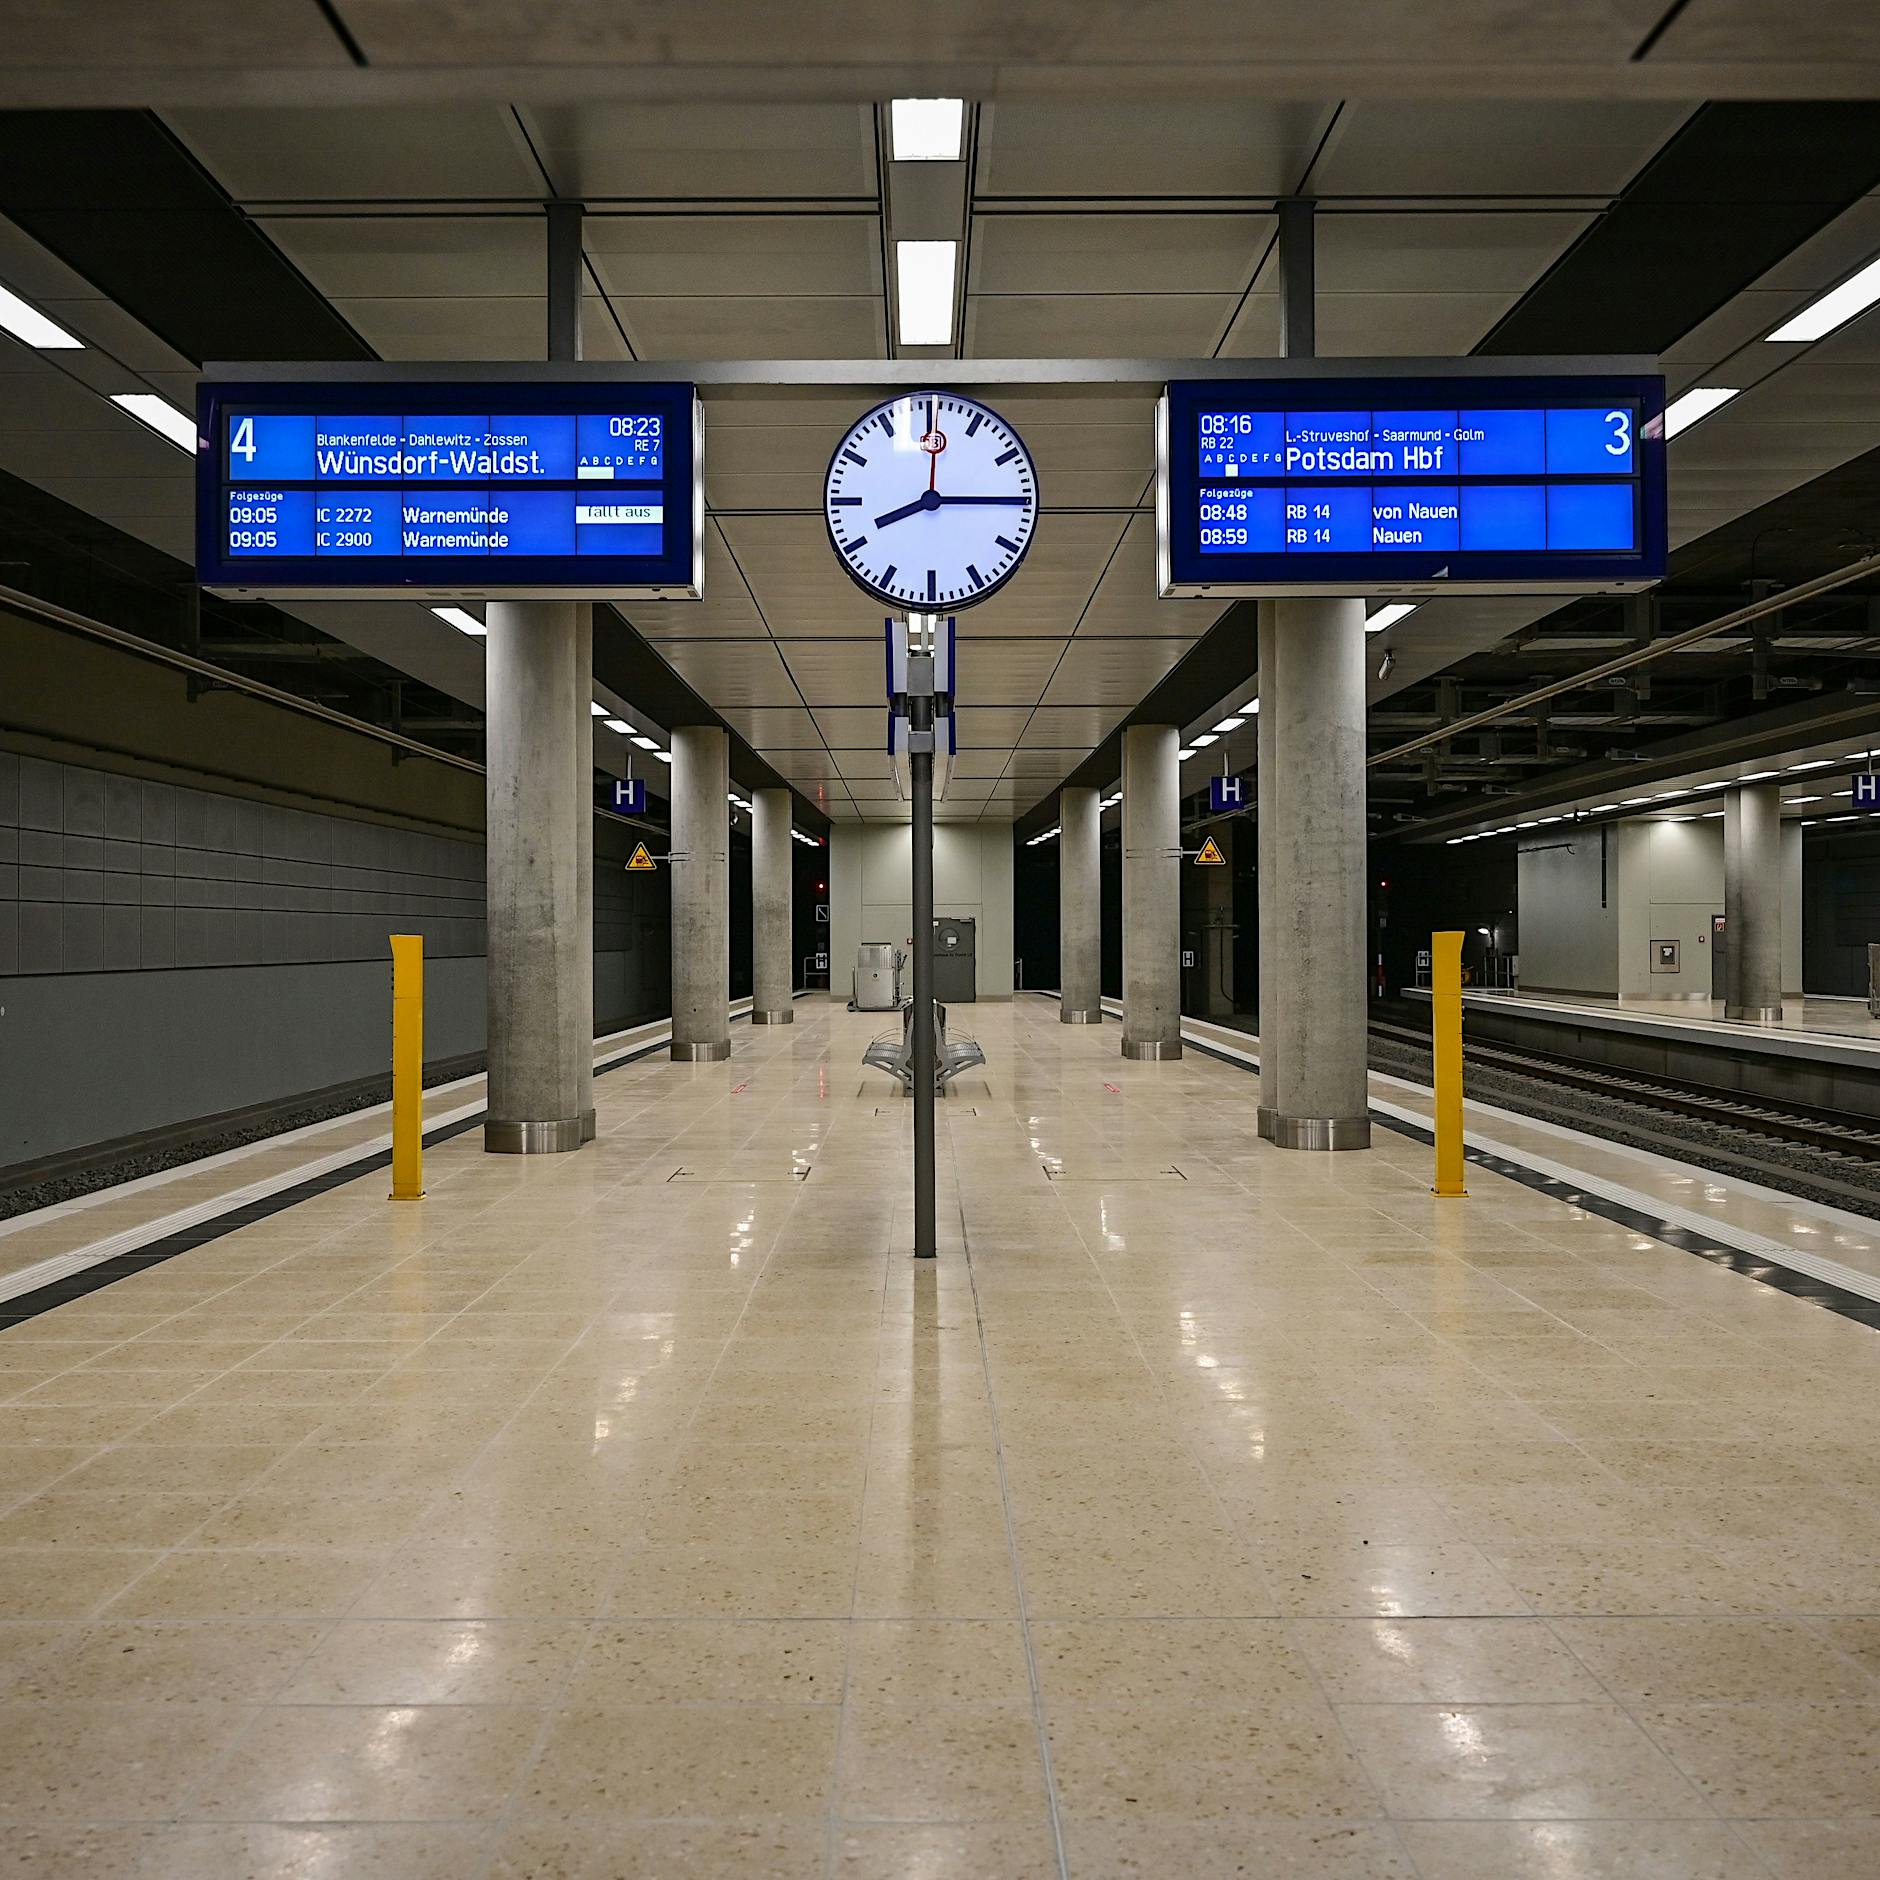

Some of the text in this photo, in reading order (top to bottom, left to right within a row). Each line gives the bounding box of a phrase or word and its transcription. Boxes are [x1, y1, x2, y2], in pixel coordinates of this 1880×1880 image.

[609, 417, 660, 437] 08:23
[1201, 414, 1252, 434] 08:16
[1604, 411, 1631, 455] 3
[231, 418, 257, 462] 4
[317, 433, 397, 446] Blankenfelde
[409, 433, 472, 446] Dahlewitz
[483, 433, 528, 446] Zossen
[1201, 436, 1234, 449] RB 22
[1286, 429, 1370, 443] L.-Struveshof
[1382, 429, 1442, 442] Saarmund
[1453, 428, 1485, 441] Golm
[634, 439, 660, 452] RE 7
[317, 450, 545, 474] Wünsdorf-Waldst.
[580, 456, 658, 466] A B C D E F G
[1204, 453, 1282, 463] A B C D E F G
[1286, 445, 1444, 471] Potsdam Hbf
[230, 491, 283, 503] Folgezüge
[1199, 488, 1253, 500] Folgezüge
[229, 507, 277, 524] 09:05
[316, 508, 331, 523] IC
[335, 508, 372, 523] 2272
[402, 507, 509, 524] Warnemünde
[625, 508, 651, 517] aus
[1200, 502, 1458, 521] 08:48 RB 14 von Nauen
[229, 531, 509, 548] 09:05 IC 2900 Warnemünde
[1200, 526, 1422, 545] 08:59 RB 14 Nauen
[616, 781, 634, 805] H
[1222, 778, 1240, 802] H
[1858, 776, 1875, 800] H
